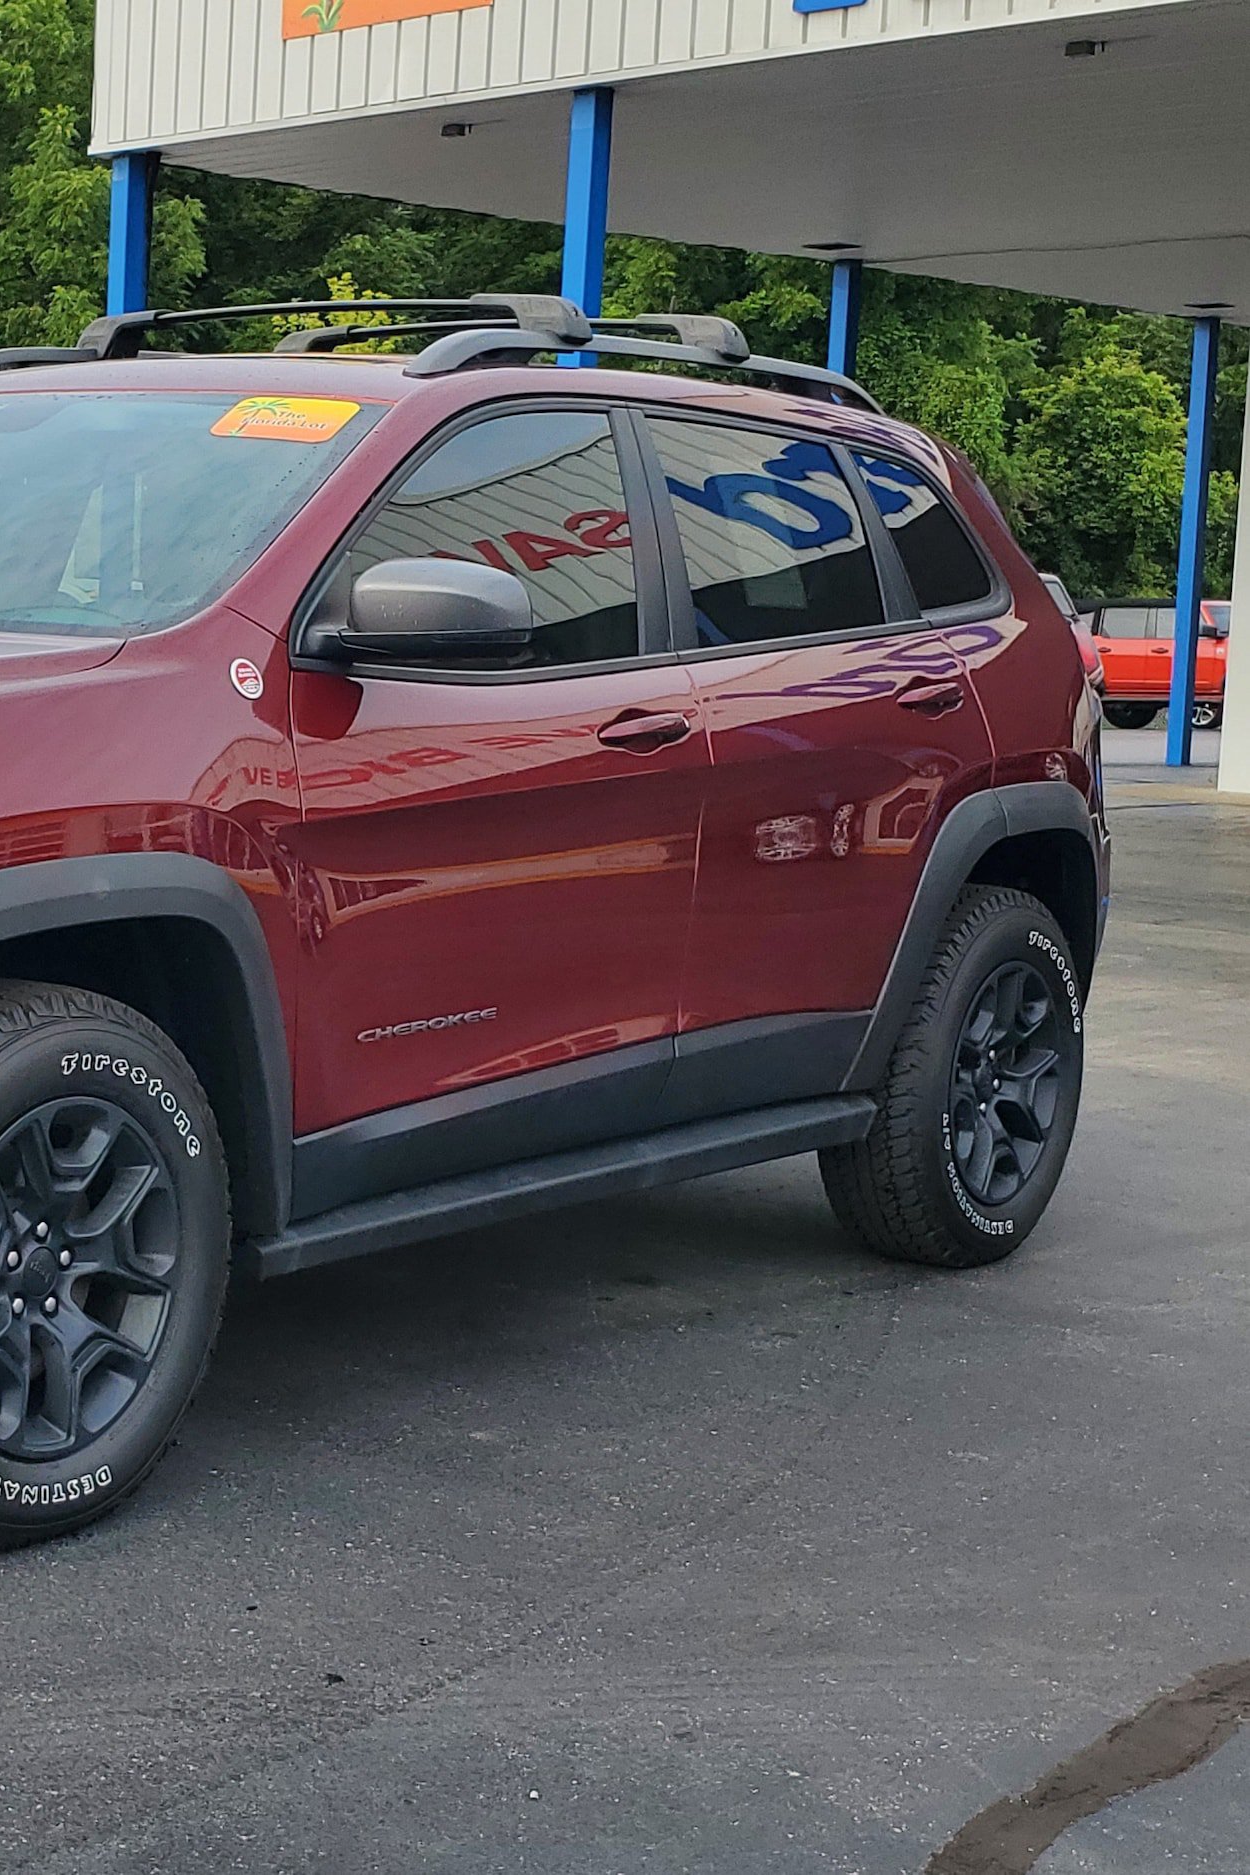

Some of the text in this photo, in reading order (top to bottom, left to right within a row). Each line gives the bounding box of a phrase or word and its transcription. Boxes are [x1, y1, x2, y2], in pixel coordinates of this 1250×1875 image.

[279, 411, 306, 419] The
[356, 1006, 499, 1043] CHEROKEE
[61, 1052, 201, 1158] Firestone
